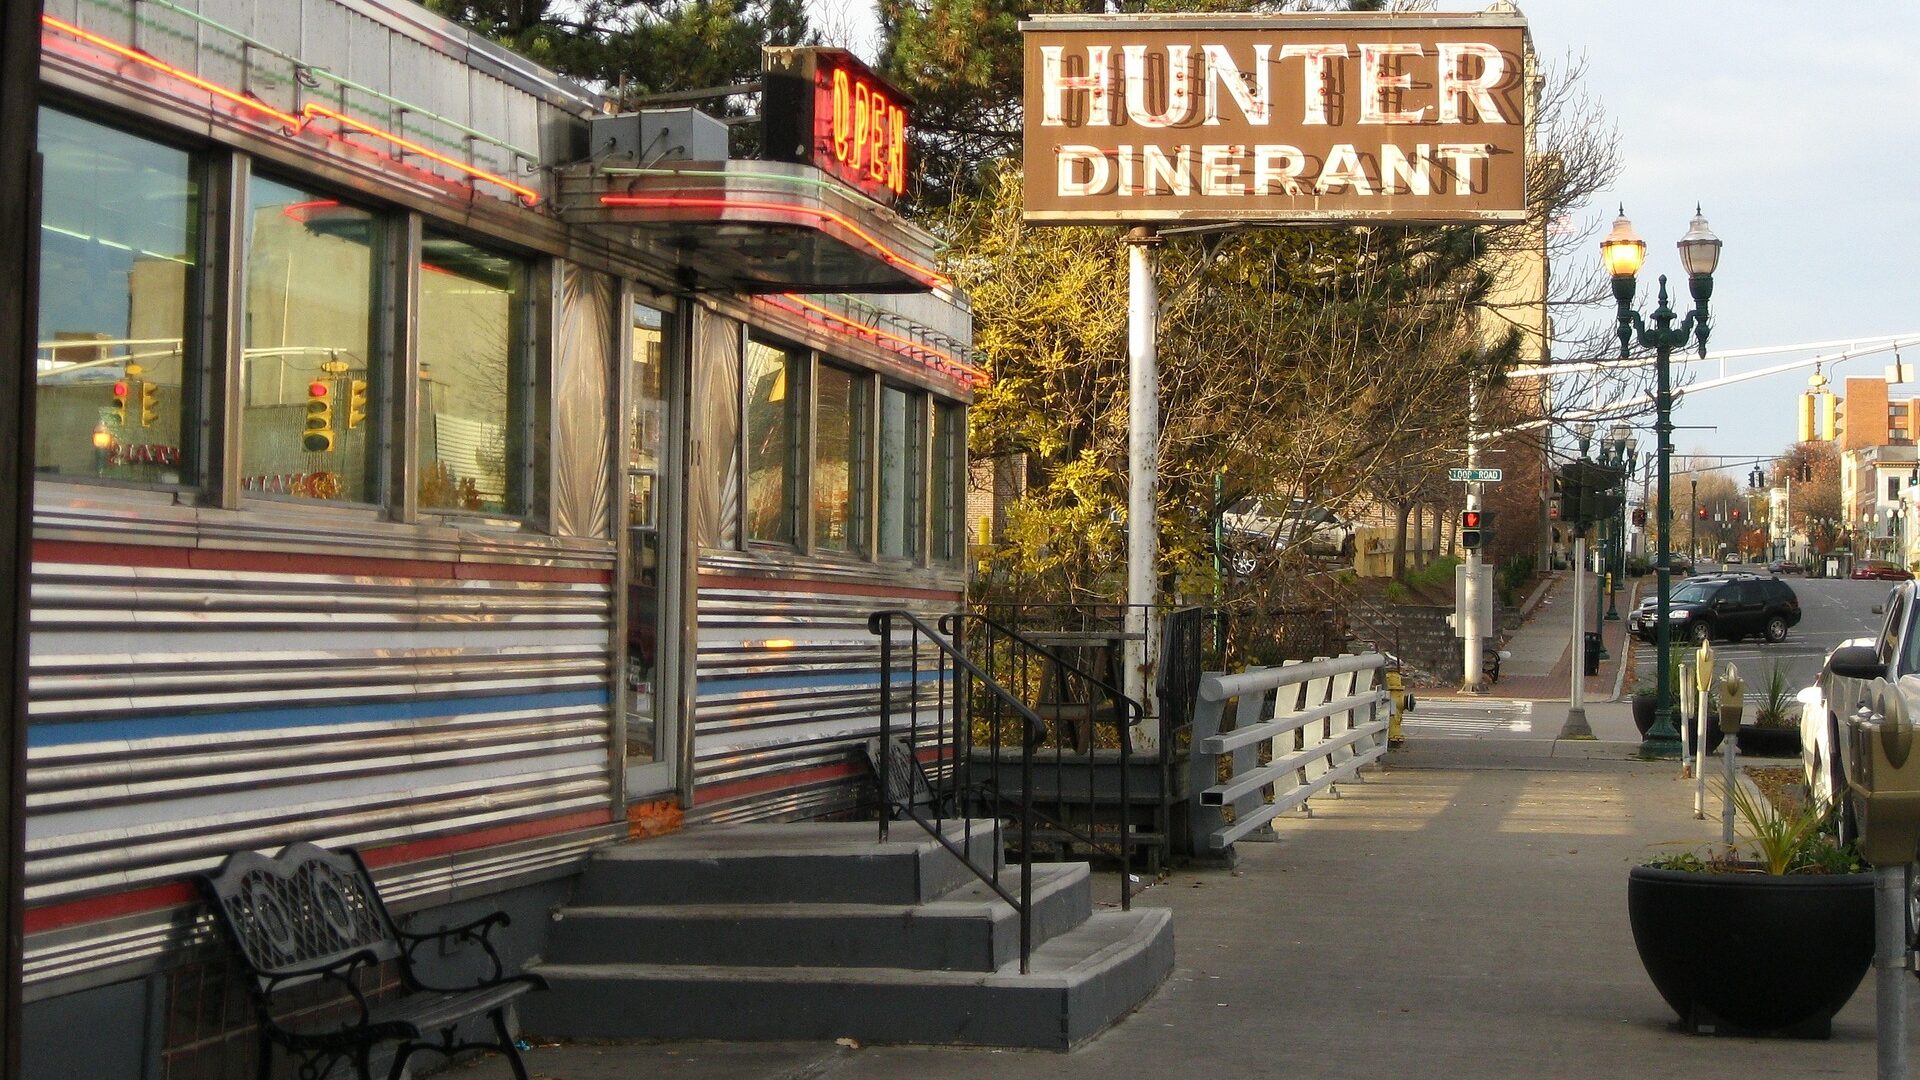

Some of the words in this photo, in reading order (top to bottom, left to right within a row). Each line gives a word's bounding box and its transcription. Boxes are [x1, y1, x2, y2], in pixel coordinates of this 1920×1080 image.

[1040, 43, 1506, 127] HUNTER
[833, 69, 904, 193] OPEN
[1057, 143, 1490, 196] DINERANT
[1478, 470, 1498, 479] ROAD
